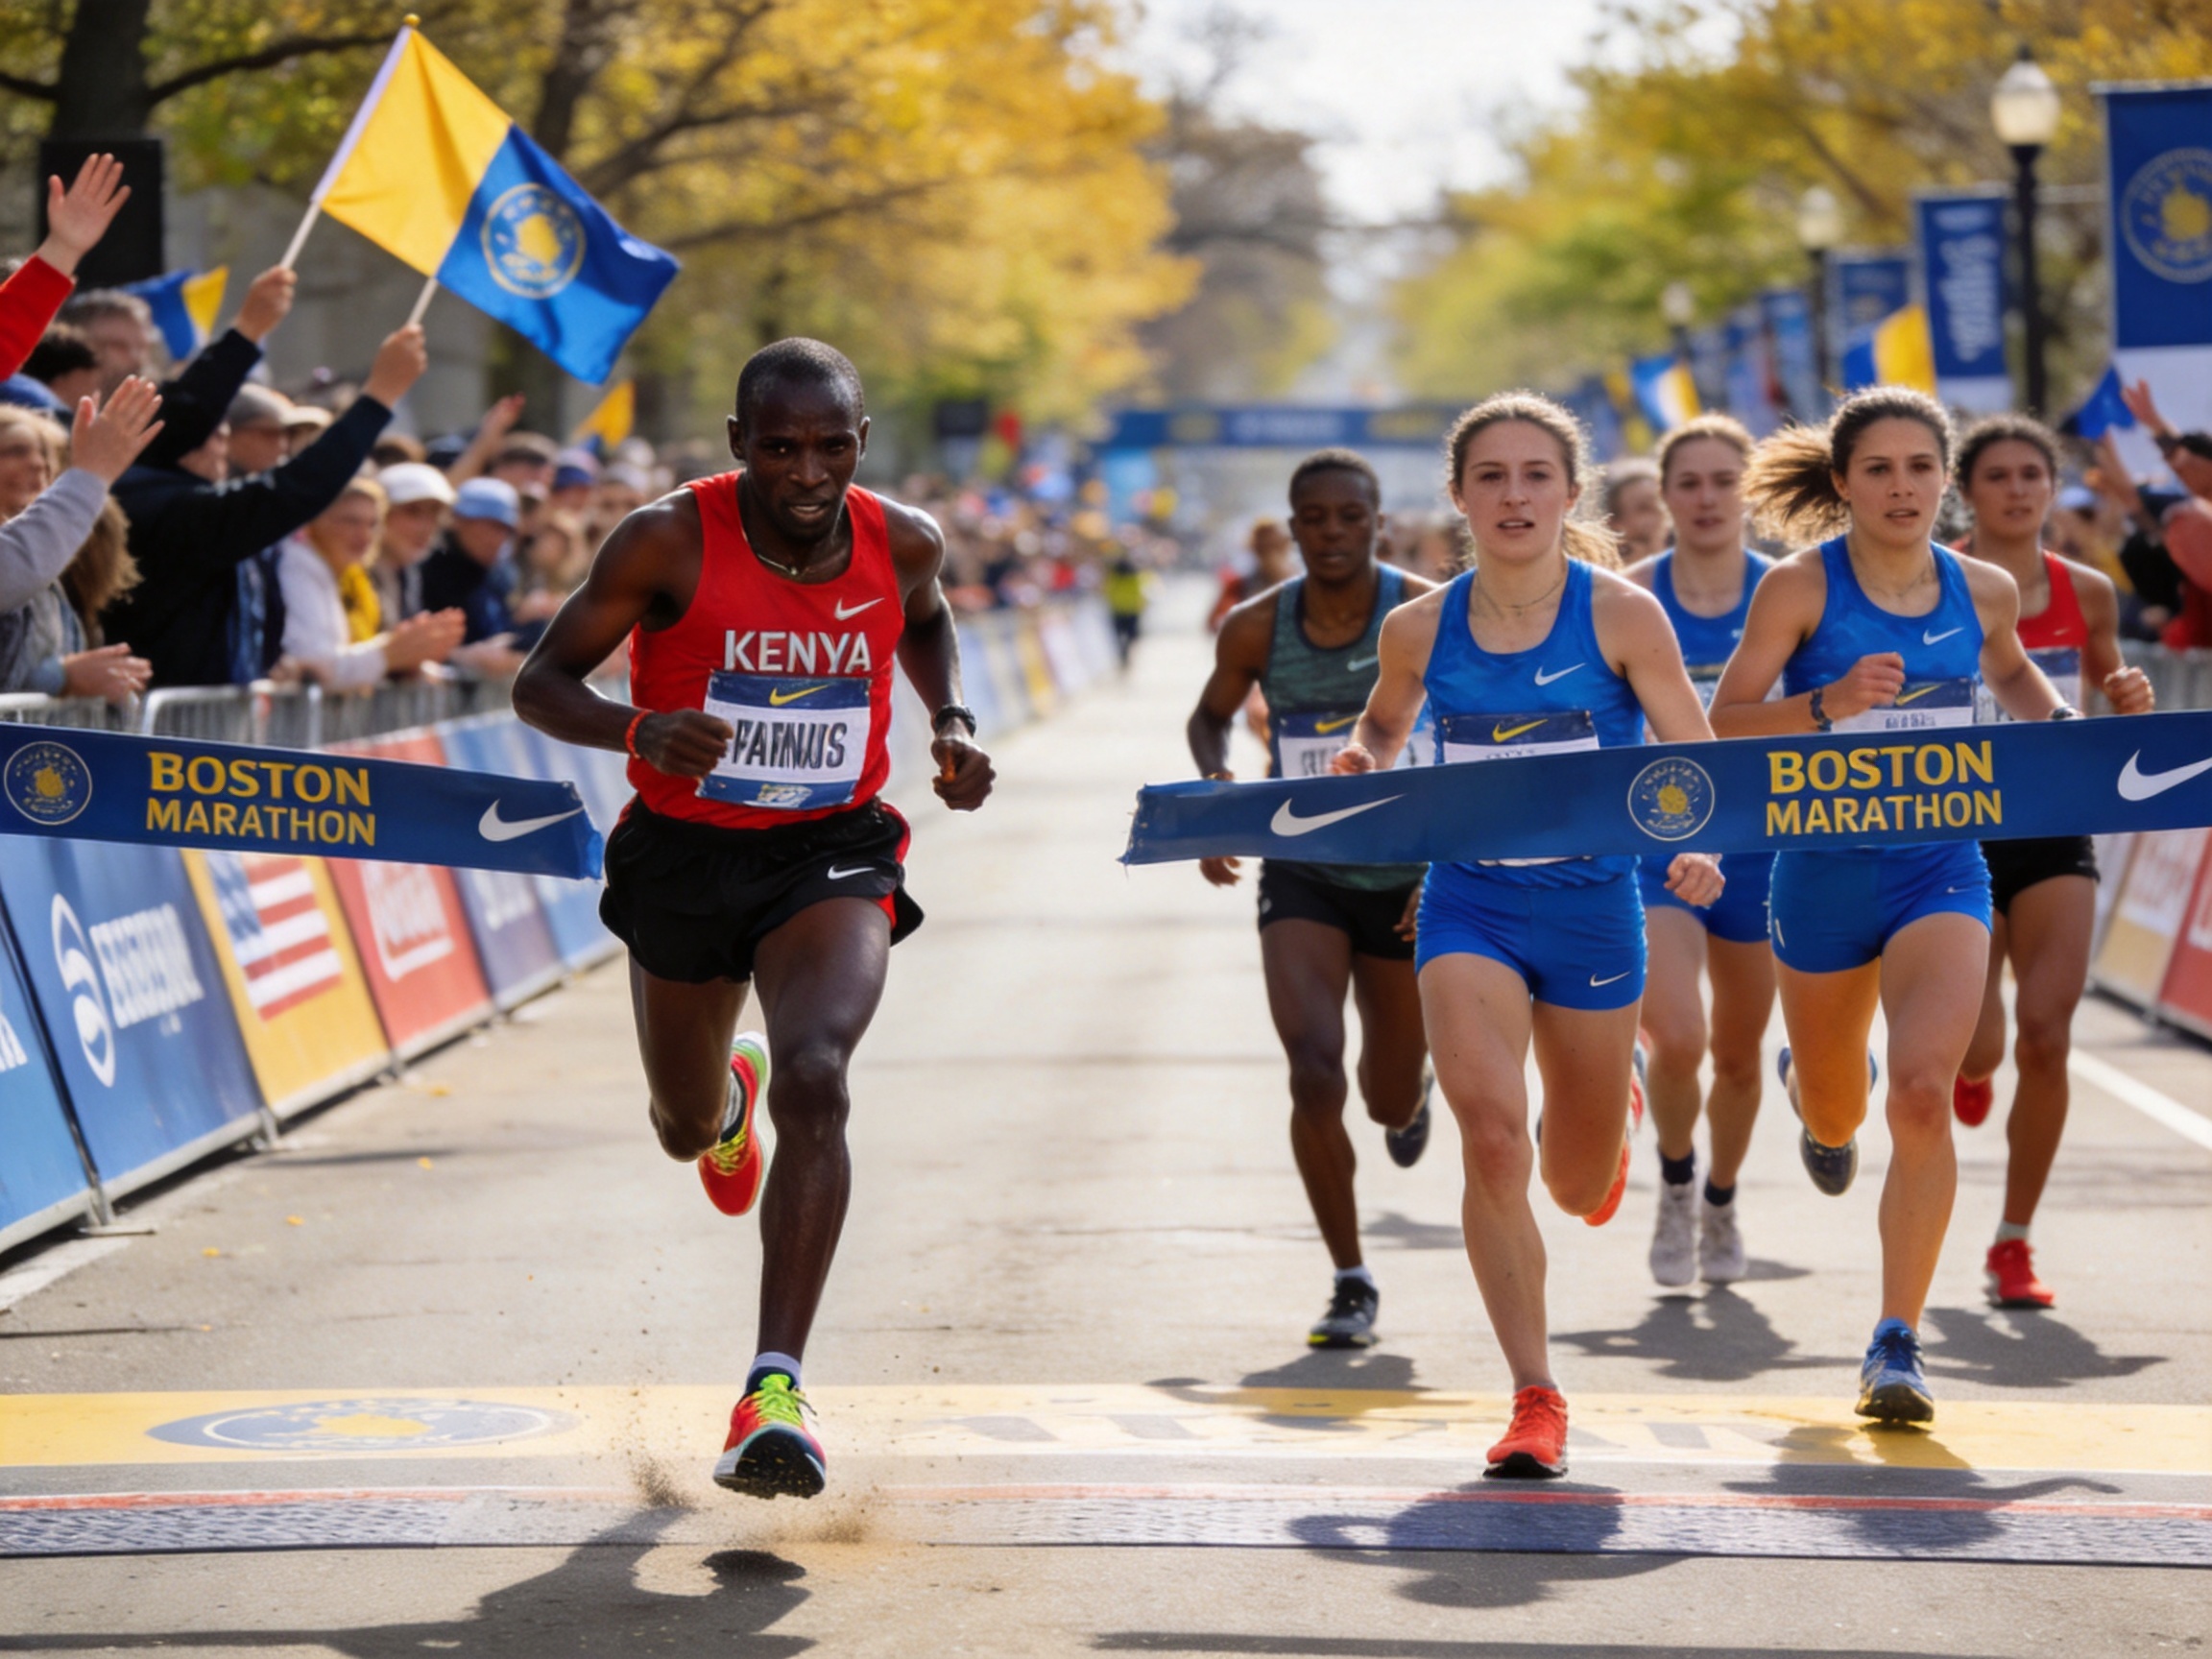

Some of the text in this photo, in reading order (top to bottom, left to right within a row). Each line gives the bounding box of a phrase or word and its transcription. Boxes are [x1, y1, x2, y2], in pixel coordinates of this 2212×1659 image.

[724, 630, 872, 674] KENYA
[147, 752, 371, 806] BOSTON
[1767, 740, 1994, 794] BOSTON
[146, 798, 375, 846] MARATHON
[1766, 790, 2002, 836] MARATHON
